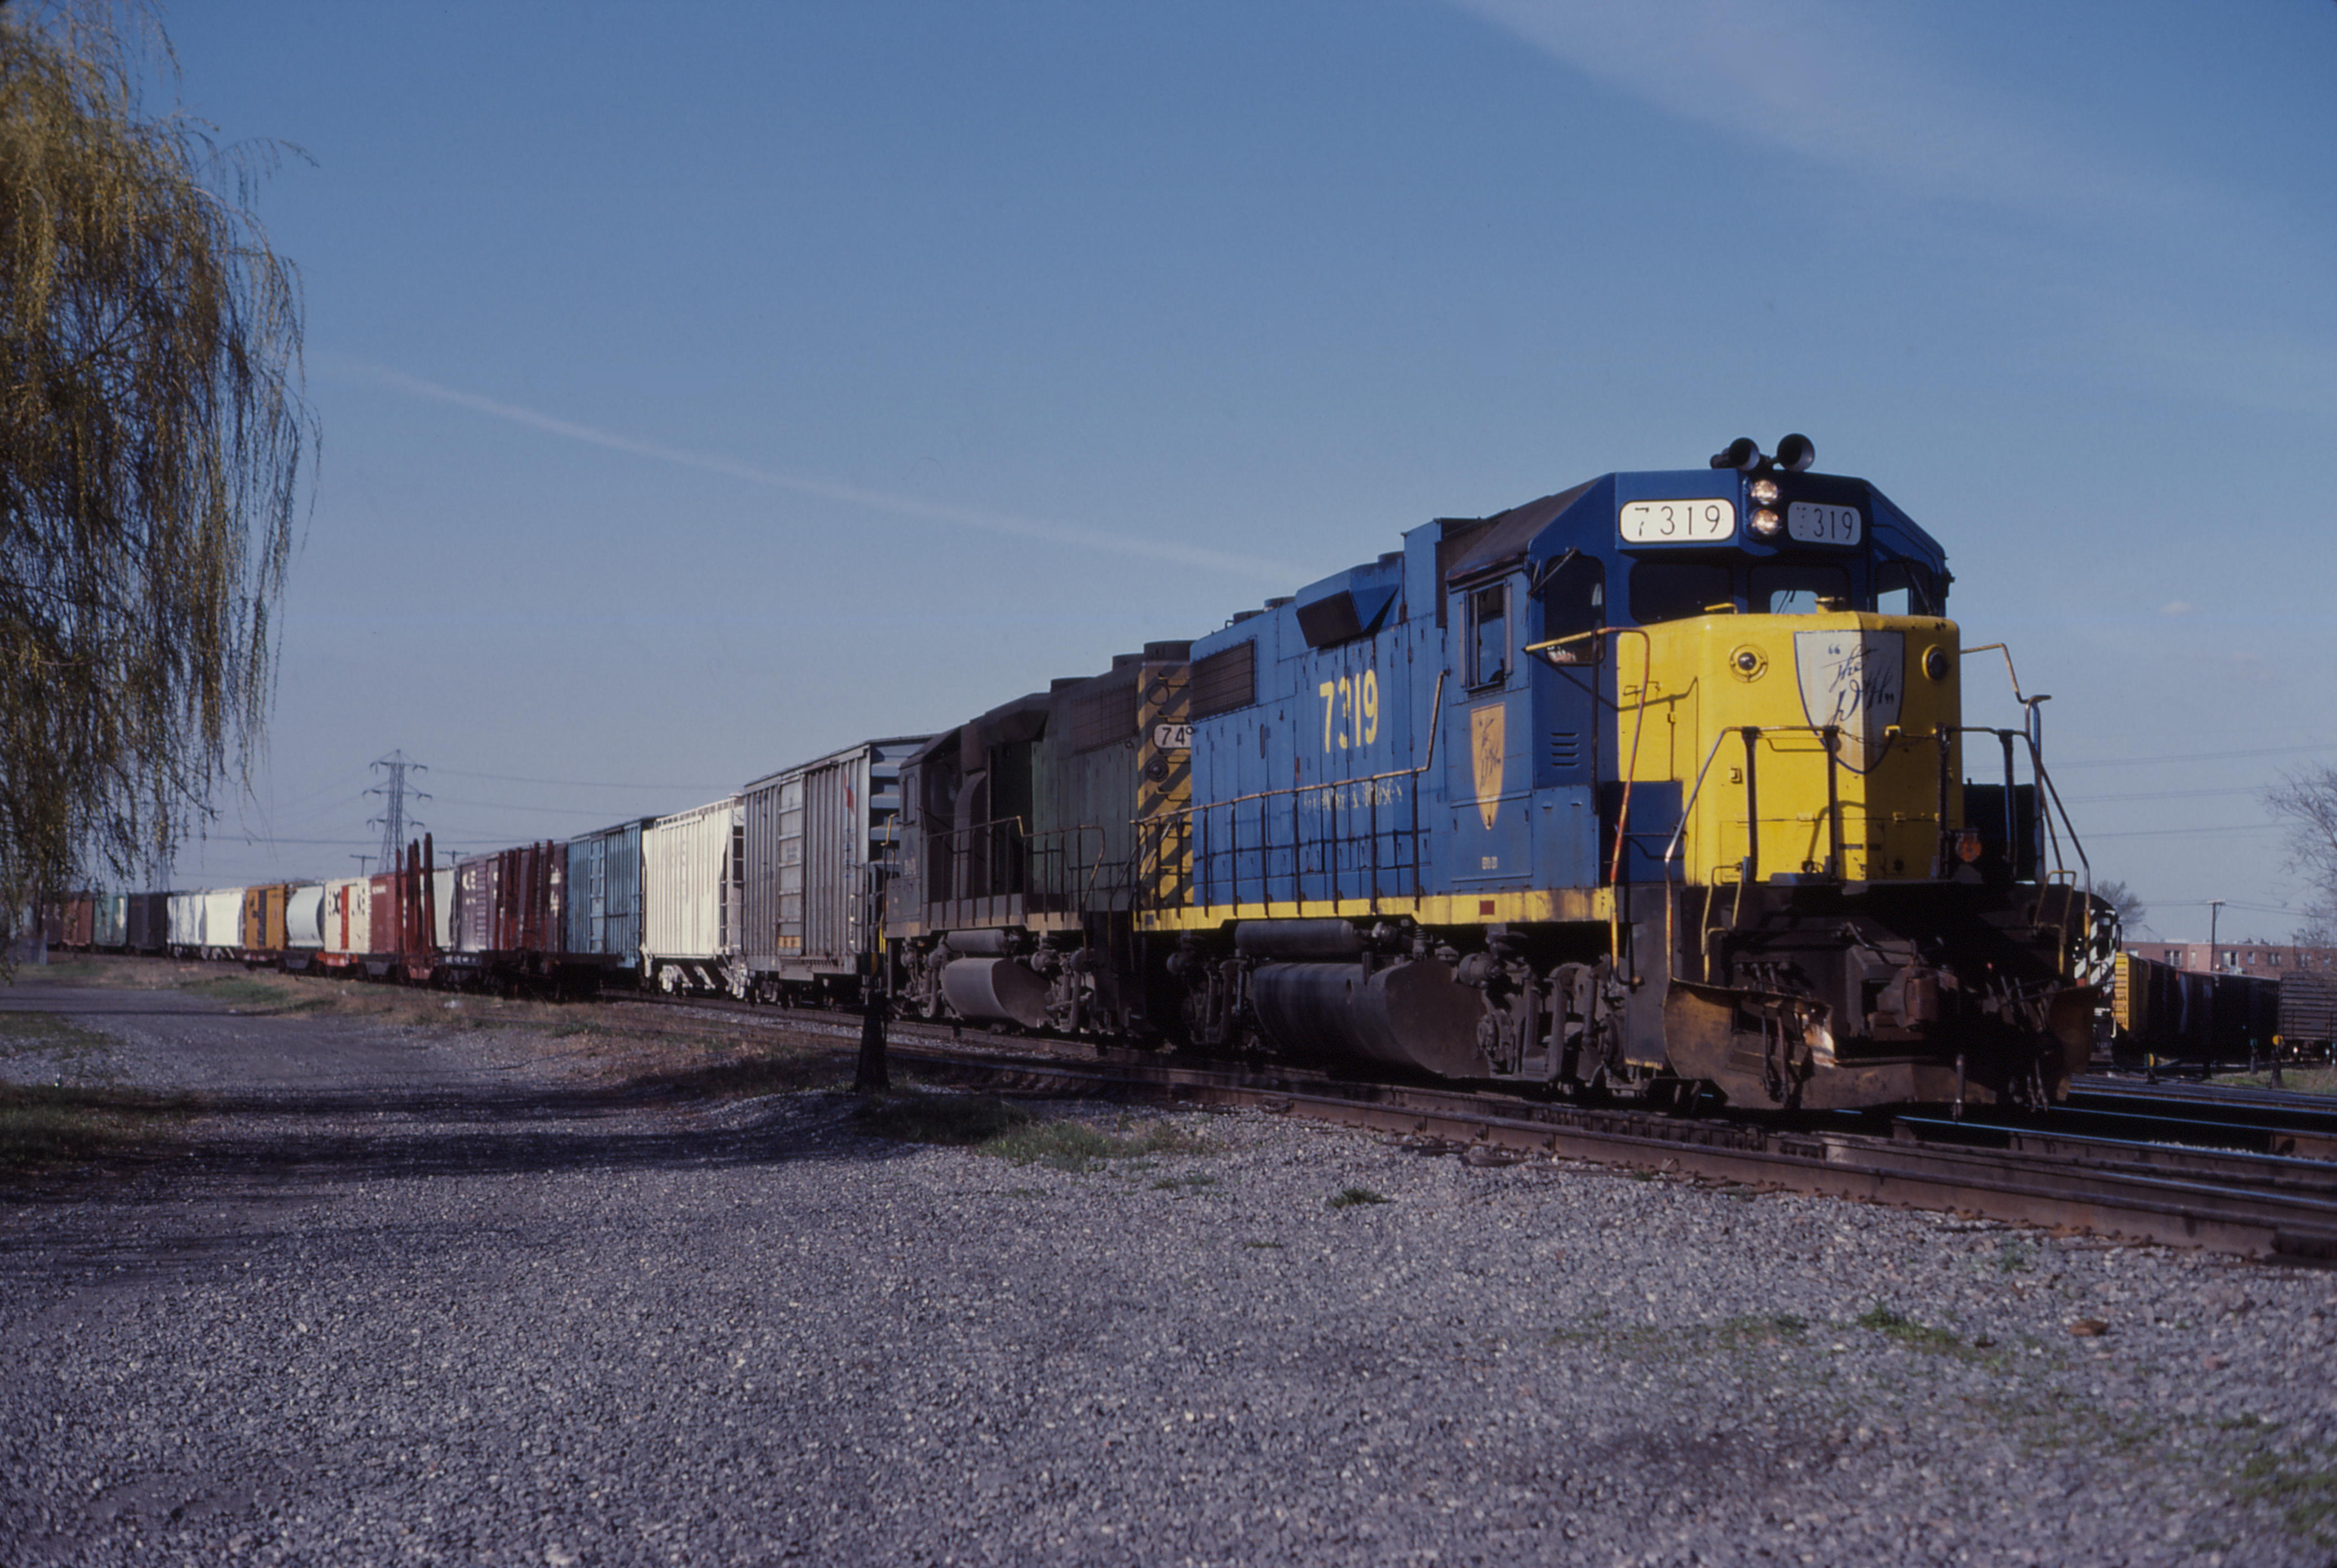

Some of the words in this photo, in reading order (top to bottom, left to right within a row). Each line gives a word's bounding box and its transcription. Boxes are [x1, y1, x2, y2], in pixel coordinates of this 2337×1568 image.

[1635, 504, 1720, 536] 7319
[1319, 669, 1378, 753] 7319
[1162, 726, 1190, 746] 74
